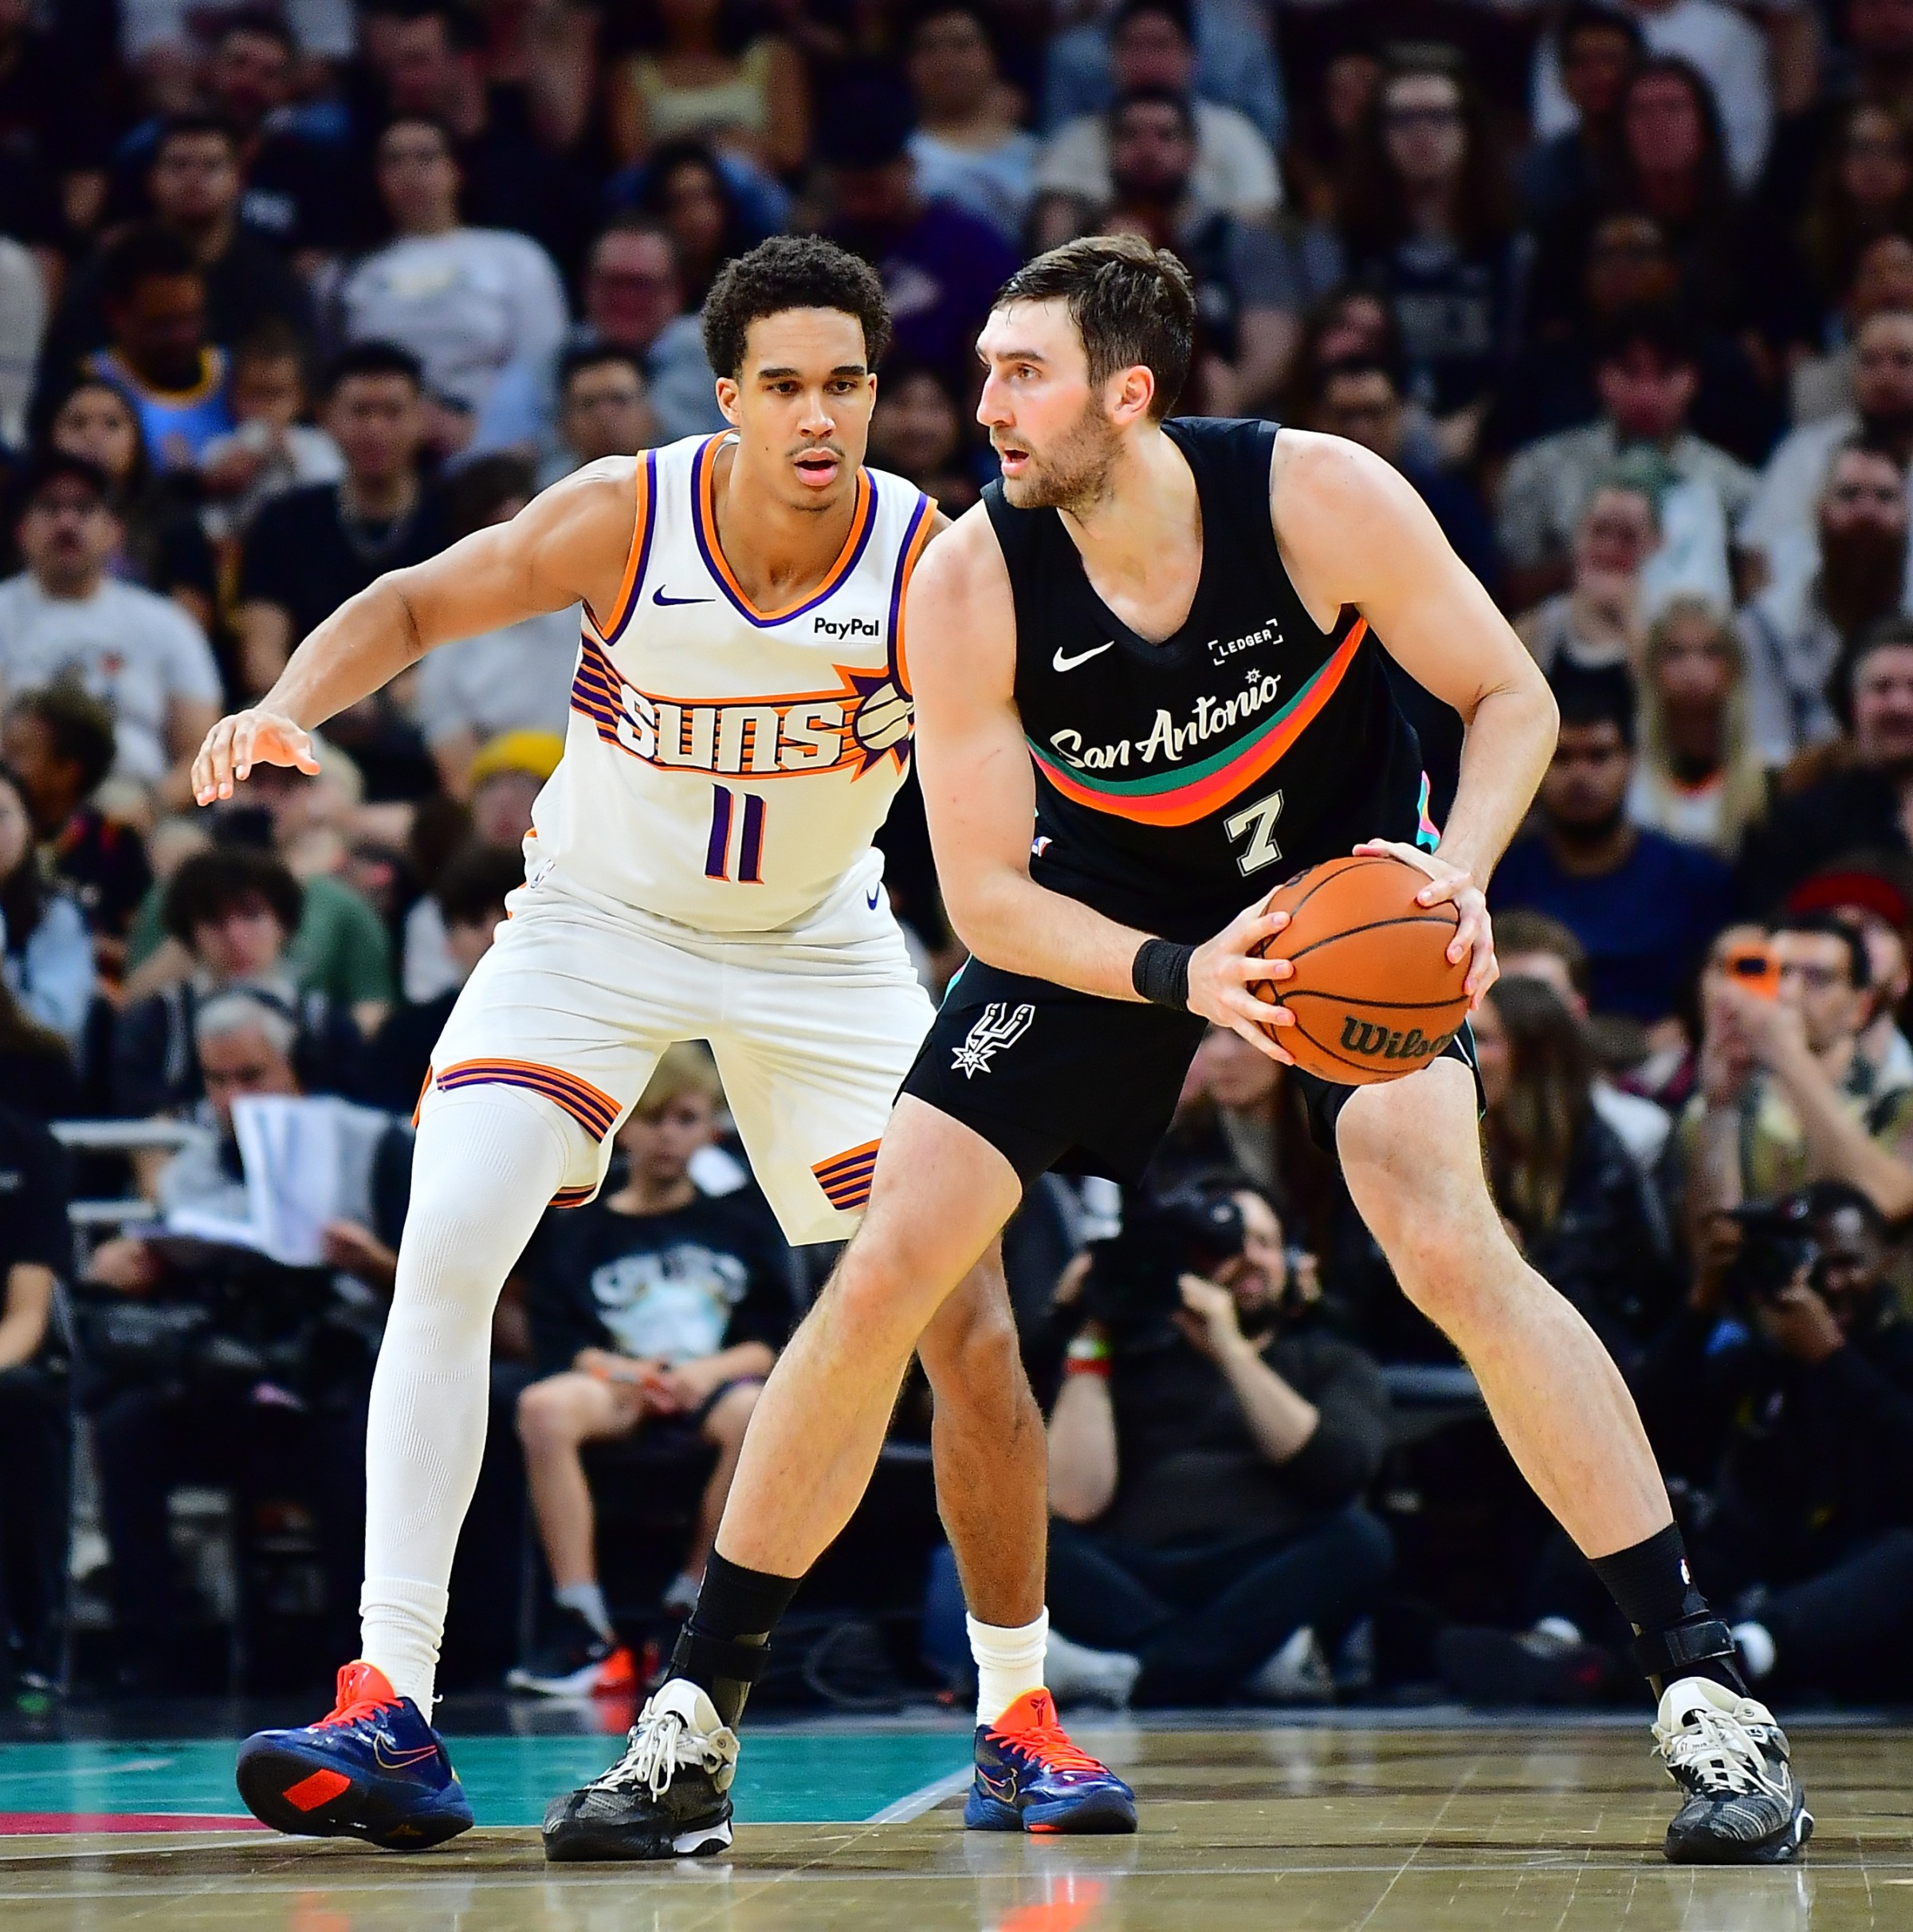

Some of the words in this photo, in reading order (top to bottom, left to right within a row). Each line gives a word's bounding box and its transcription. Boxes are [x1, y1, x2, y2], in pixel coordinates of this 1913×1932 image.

[814, 617, 879, 640] PayPal
[1219, 629, 1272, 656] LEDGER
[1050, 728, 1130, 768] San
[1135, 668, 1282, 763] Antonio
[705, 783, 766, 885] 11
[1223, 789, 1284, 877] 7
[1341, 1015, 1459, 1058] Wilso
